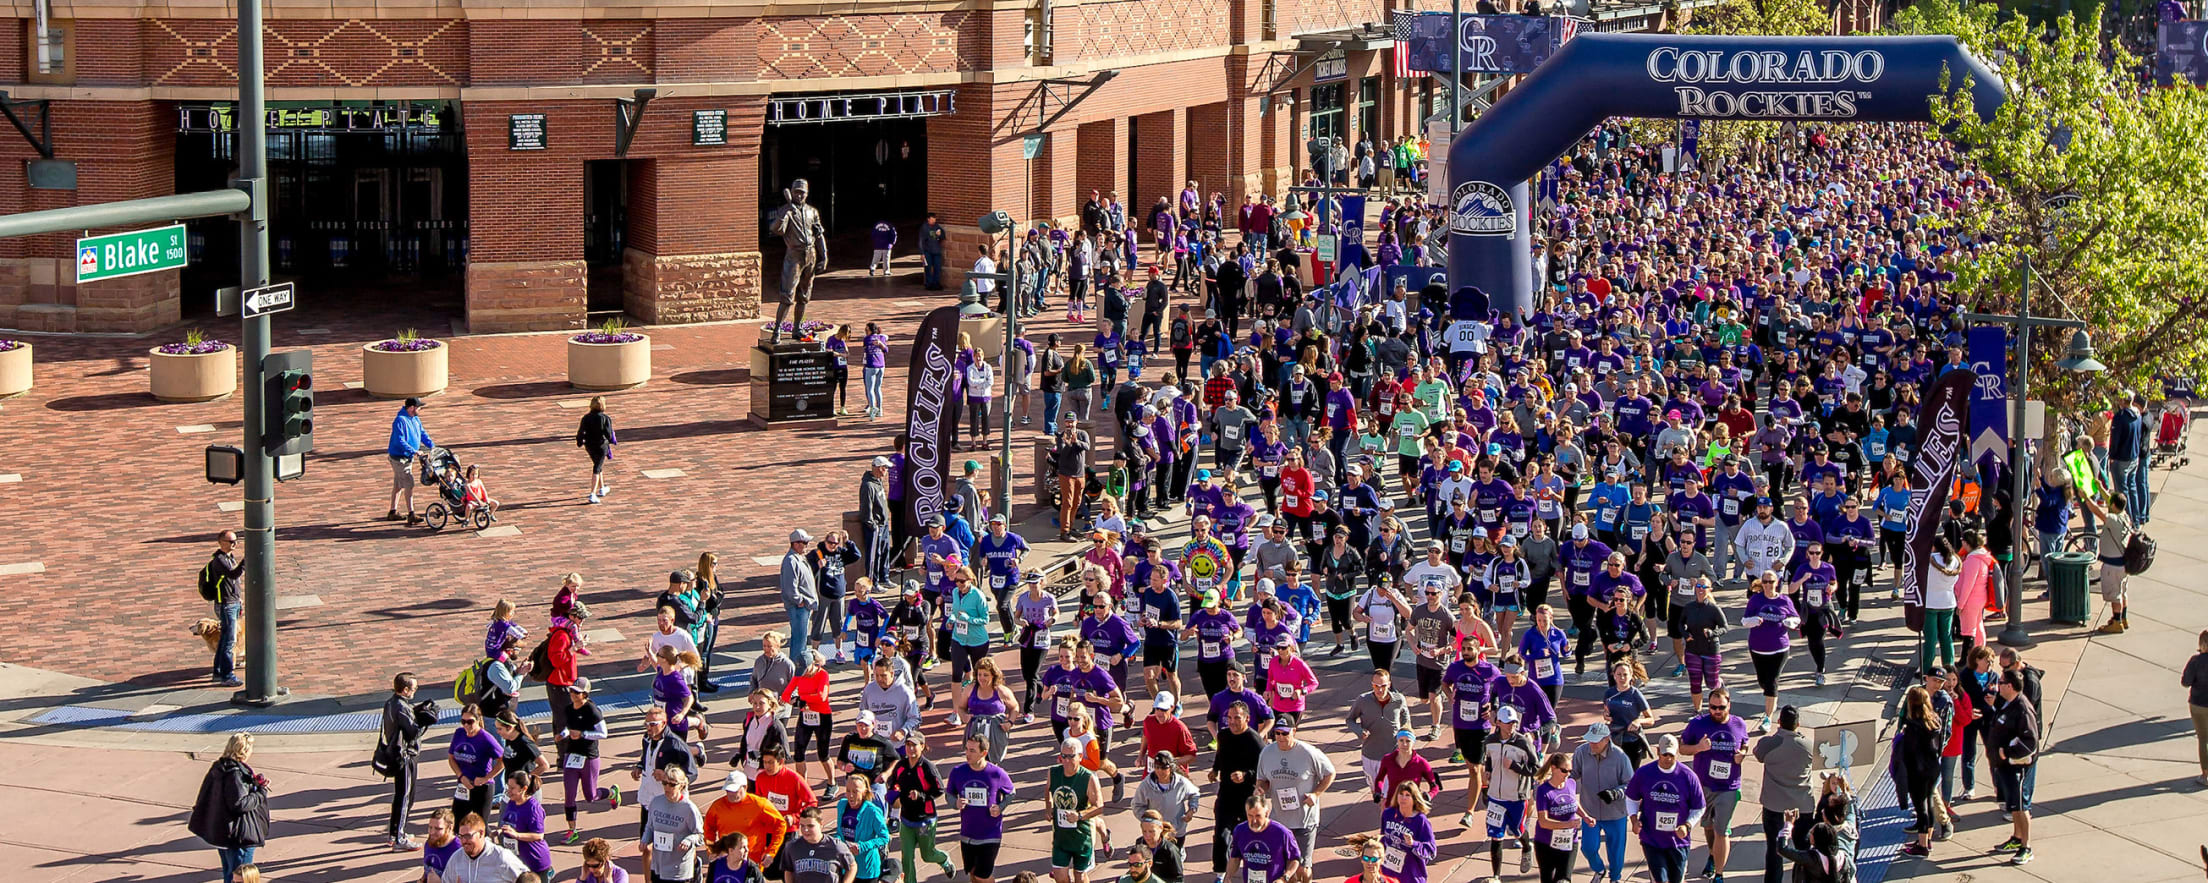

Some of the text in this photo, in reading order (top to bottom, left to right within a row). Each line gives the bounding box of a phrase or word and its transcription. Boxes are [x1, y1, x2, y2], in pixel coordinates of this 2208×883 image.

[1646, 46, 1885, 84] COLORADO
[773, 92, 956, 121] HOME PLATE
[1675, 86, 1857, 119] ROCKIES
[181, 109, 433, 130] HOE PLATE
[1450, 213, 1514, 231] ROCKIES
[105, 234, 178, 271] Blake St
[166, 247, 183, 260] 1500
[258, 292, 289, 307] ONE WAY
[1459, 330, 1474, 341] 00
[909, 342, 953, 527] ROCKIES
[1766, 546, 1780, 557] 28
[1650, 791, 1679, 800] COLORADO
[653, 810, 684, 823] COLORADO
[659, 836, 666, 844] 11
[1243, 852, 1271, 860] COLORADO
[1385, 853, 1401, 867] 4301
